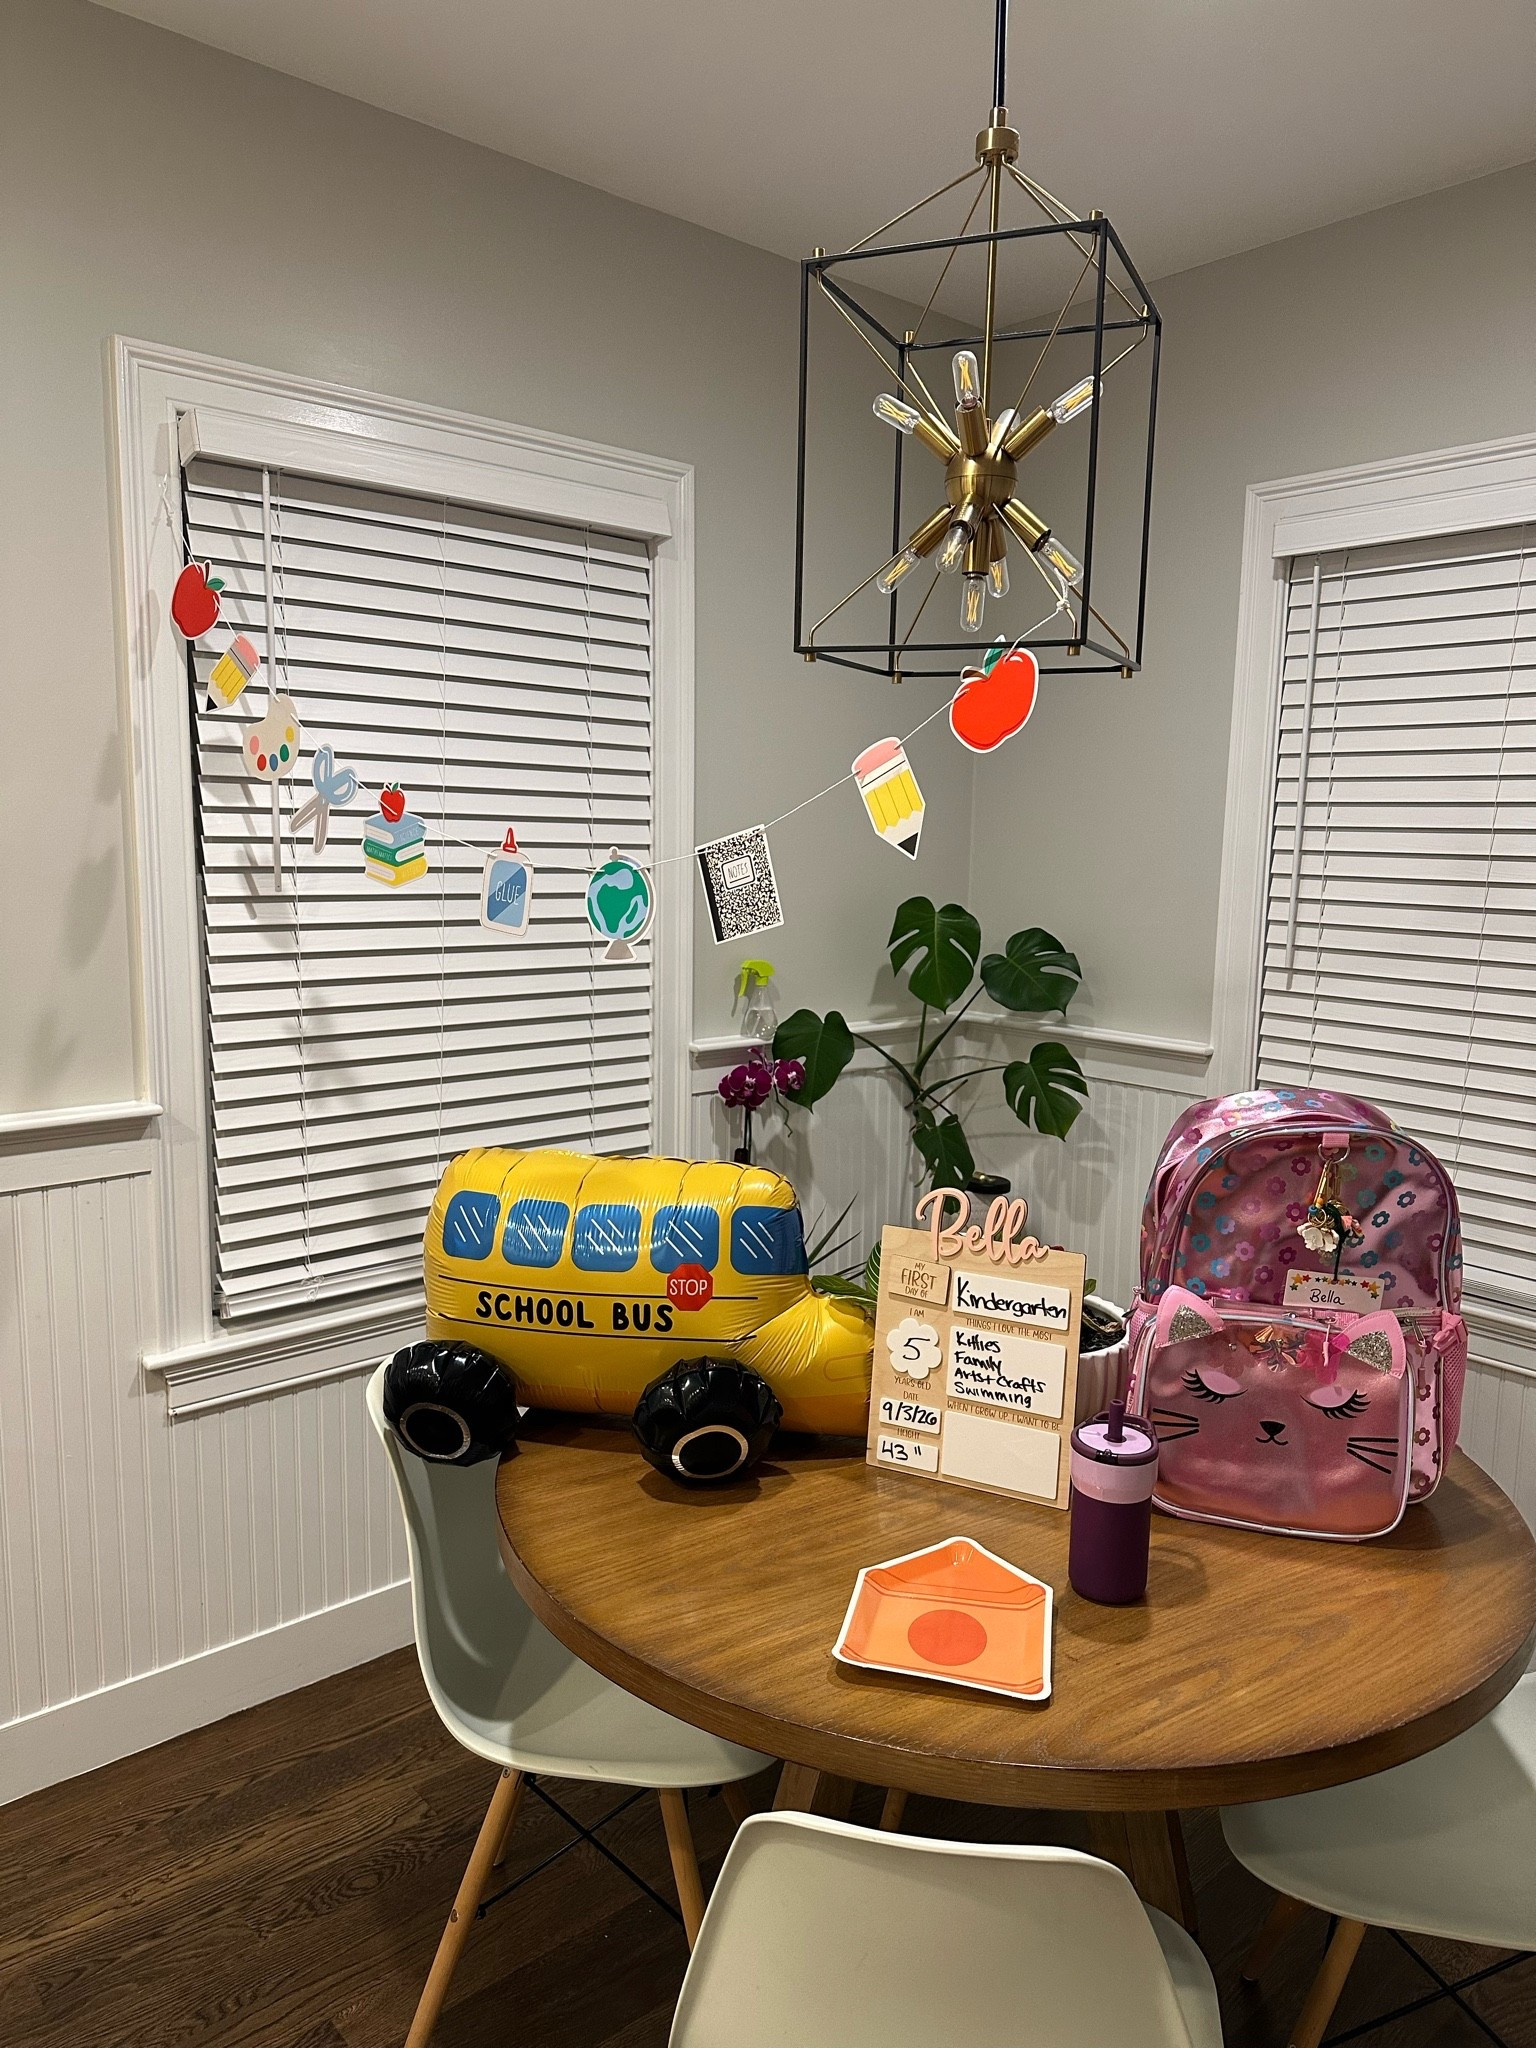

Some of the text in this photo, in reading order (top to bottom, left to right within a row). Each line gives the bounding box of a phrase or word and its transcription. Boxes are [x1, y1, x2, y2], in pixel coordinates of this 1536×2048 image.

[728, 862, 748, 879] NOTES
[495, 881, 521, 905] GLUE
[915, 1187, 1050, 1264] Bella
[915, 1263, 925, 1271] MY
[670, 1279, 708, 1296] STOP
[901, 1268, 937, 1290] FIRST
[905, 1286, 928, 1298] DAY OF
[957, 1276, 1067, 1319] Kindergarten
[1309, 1288, 1345, 1305] Bella
[476, 1291, 674, 1332] SCHOOL BUS
[914, 1309, 924, 1318] AM
[966, 1318, 991, 1331] THINGS
[997, 1322, 1014, 1334] LOVE
[1018, 1327, 1030, 1337] THE
[1032, 1330, 1053, 1341] MOST
[902, 1337, 931, 1360] 5
[956, 1331, 1001, 1353] Kitties
[954, 1351, 1002, 1376] Family
[894, 1375, 931, 1391] YEARS OLD
[903, 1391, 919, 1401] DATE
[954, 1381, 1032, 1409] Swimming
[882, 1401, 938, 1426] 9/3/26
[947, 1400, 968, 1412] WHEN
[974, 1405, 997, 1418] GROW
[1016, 1414, 1038, 1427] WANT
[1040, 1420, 1050, 1429] TO
[1051, 1421, 1061, 1431] BE
[896, 1428, 921, 1440] HEIGHT
